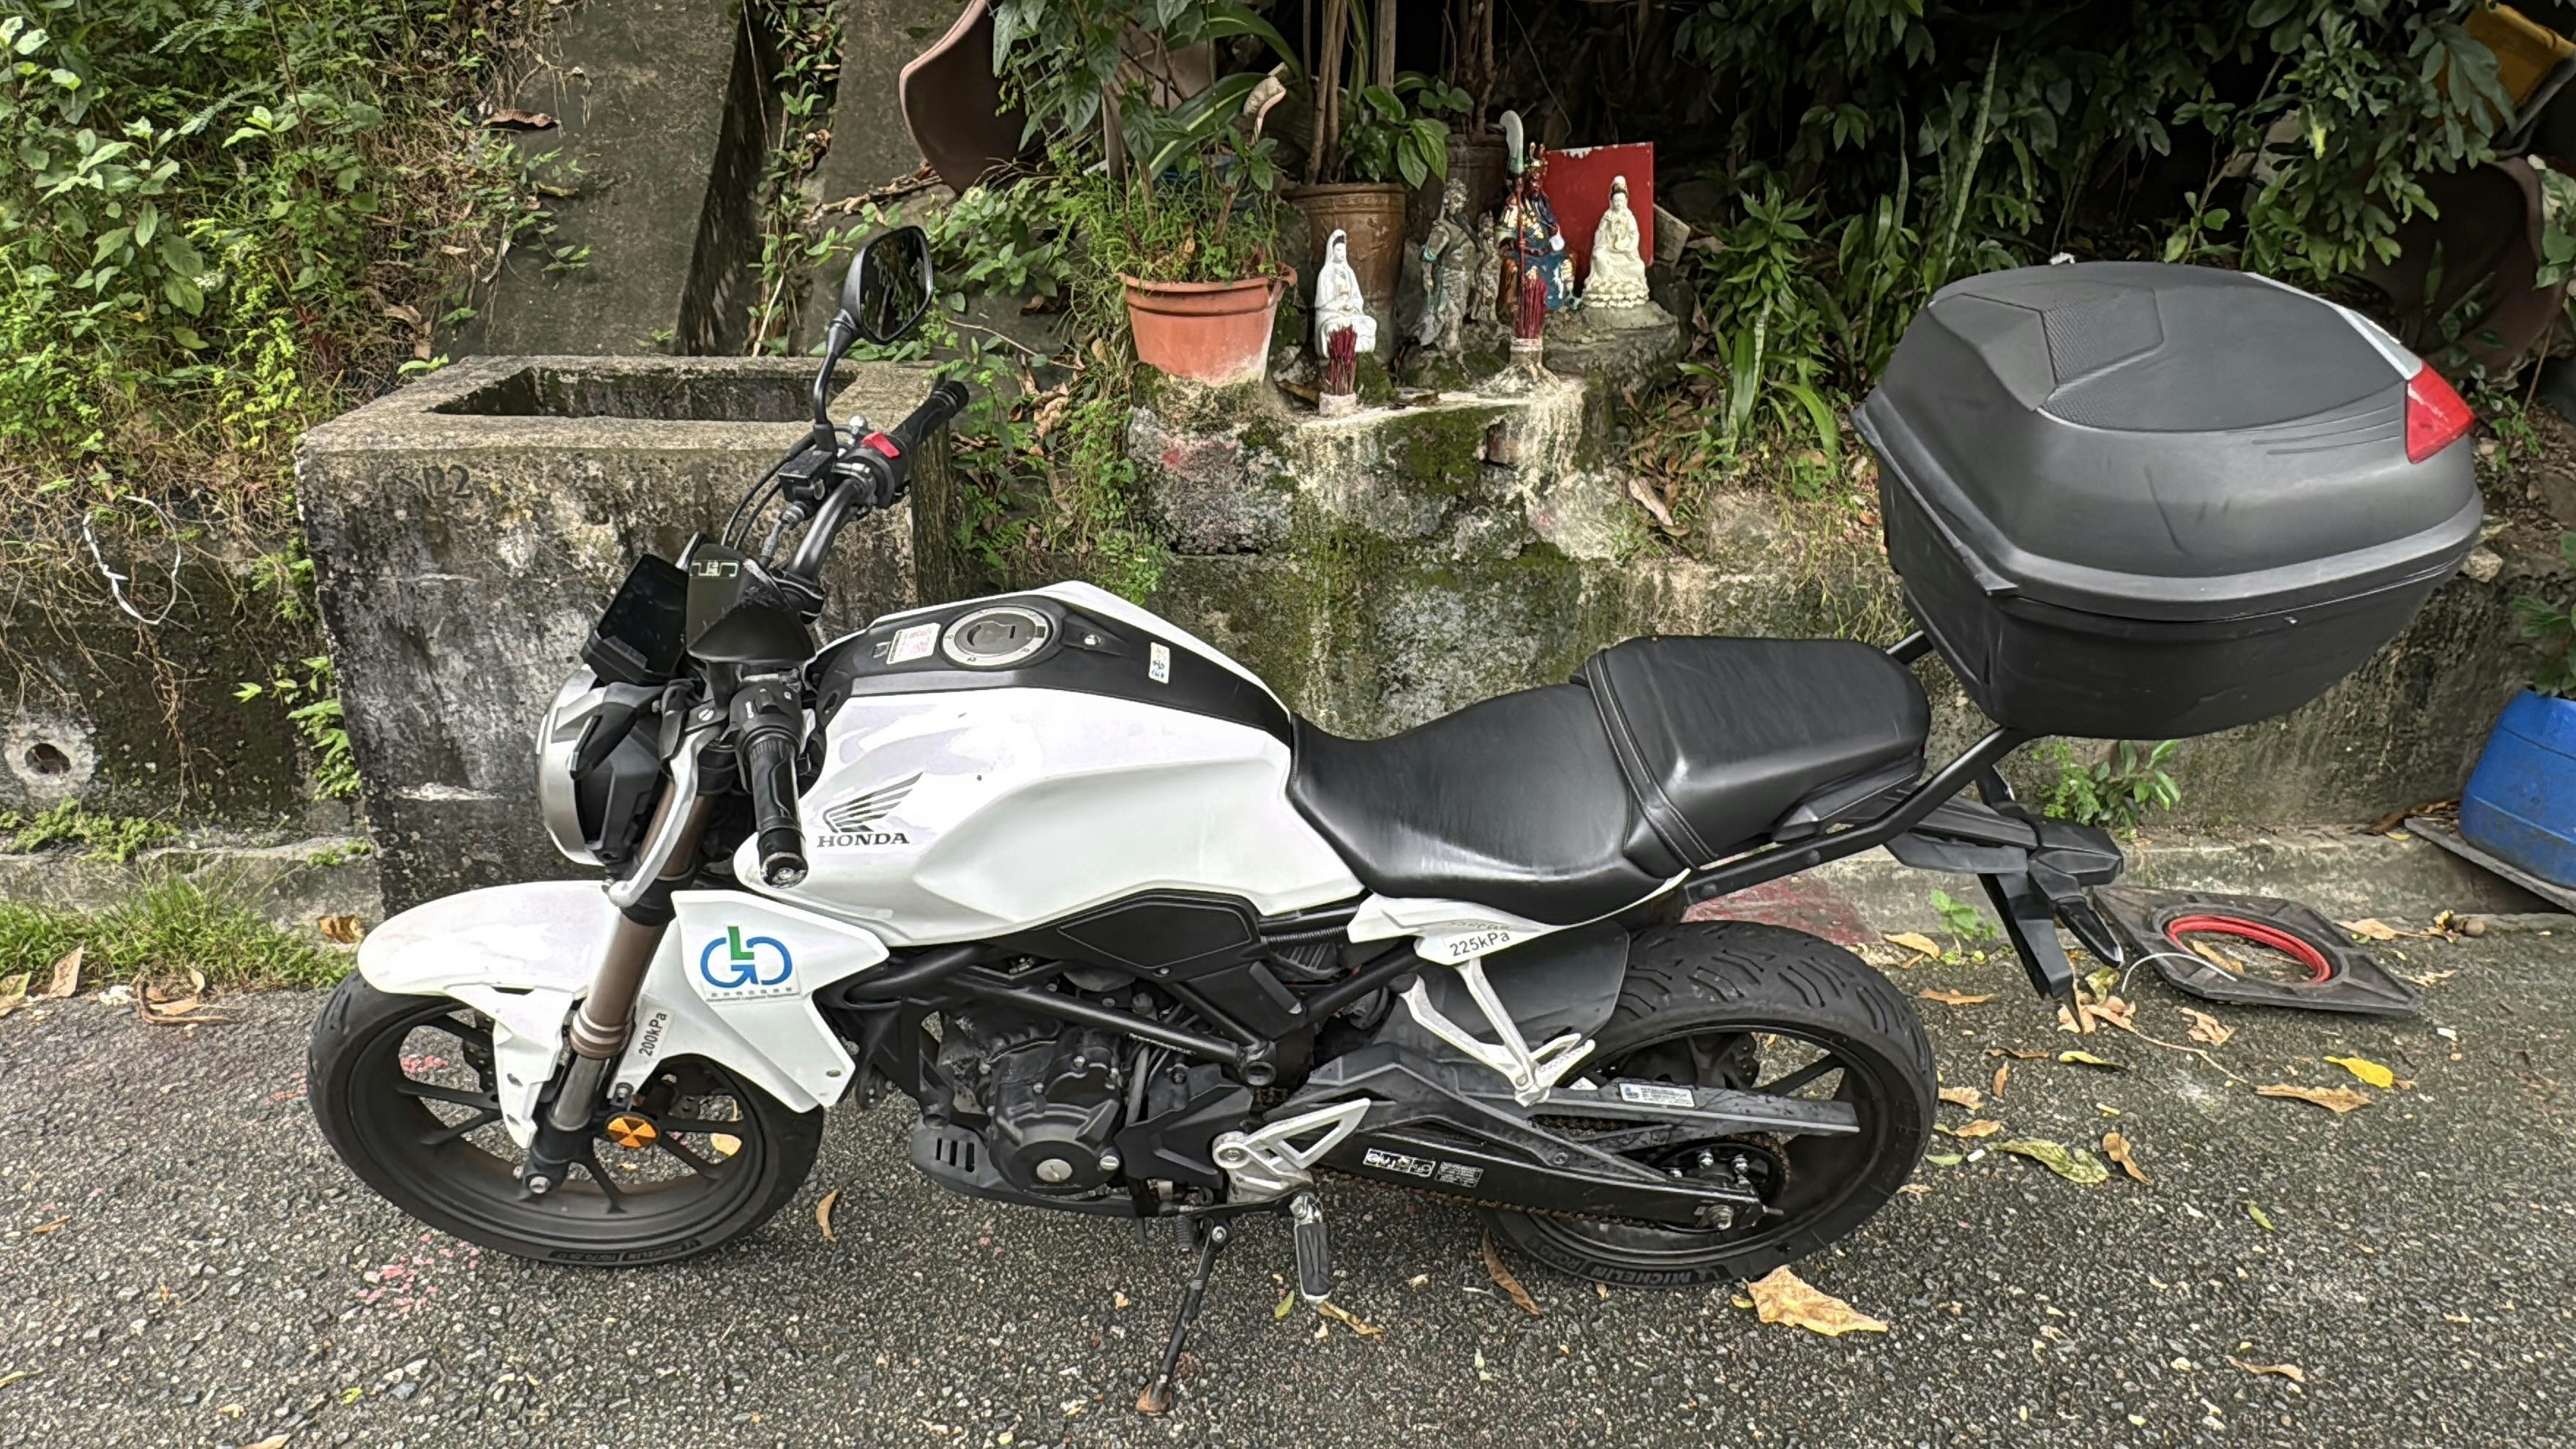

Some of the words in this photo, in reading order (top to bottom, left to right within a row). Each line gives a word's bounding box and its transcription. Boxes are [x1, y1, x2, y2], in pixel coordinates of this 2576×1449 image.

[817, 833, 910, 847] HONDA
[1450, 932, 1510, 956] 225kPa
[639, 1013, 667, 1057] 200kPa
[1590, 1266, 1691, 1284] MICHELIN
